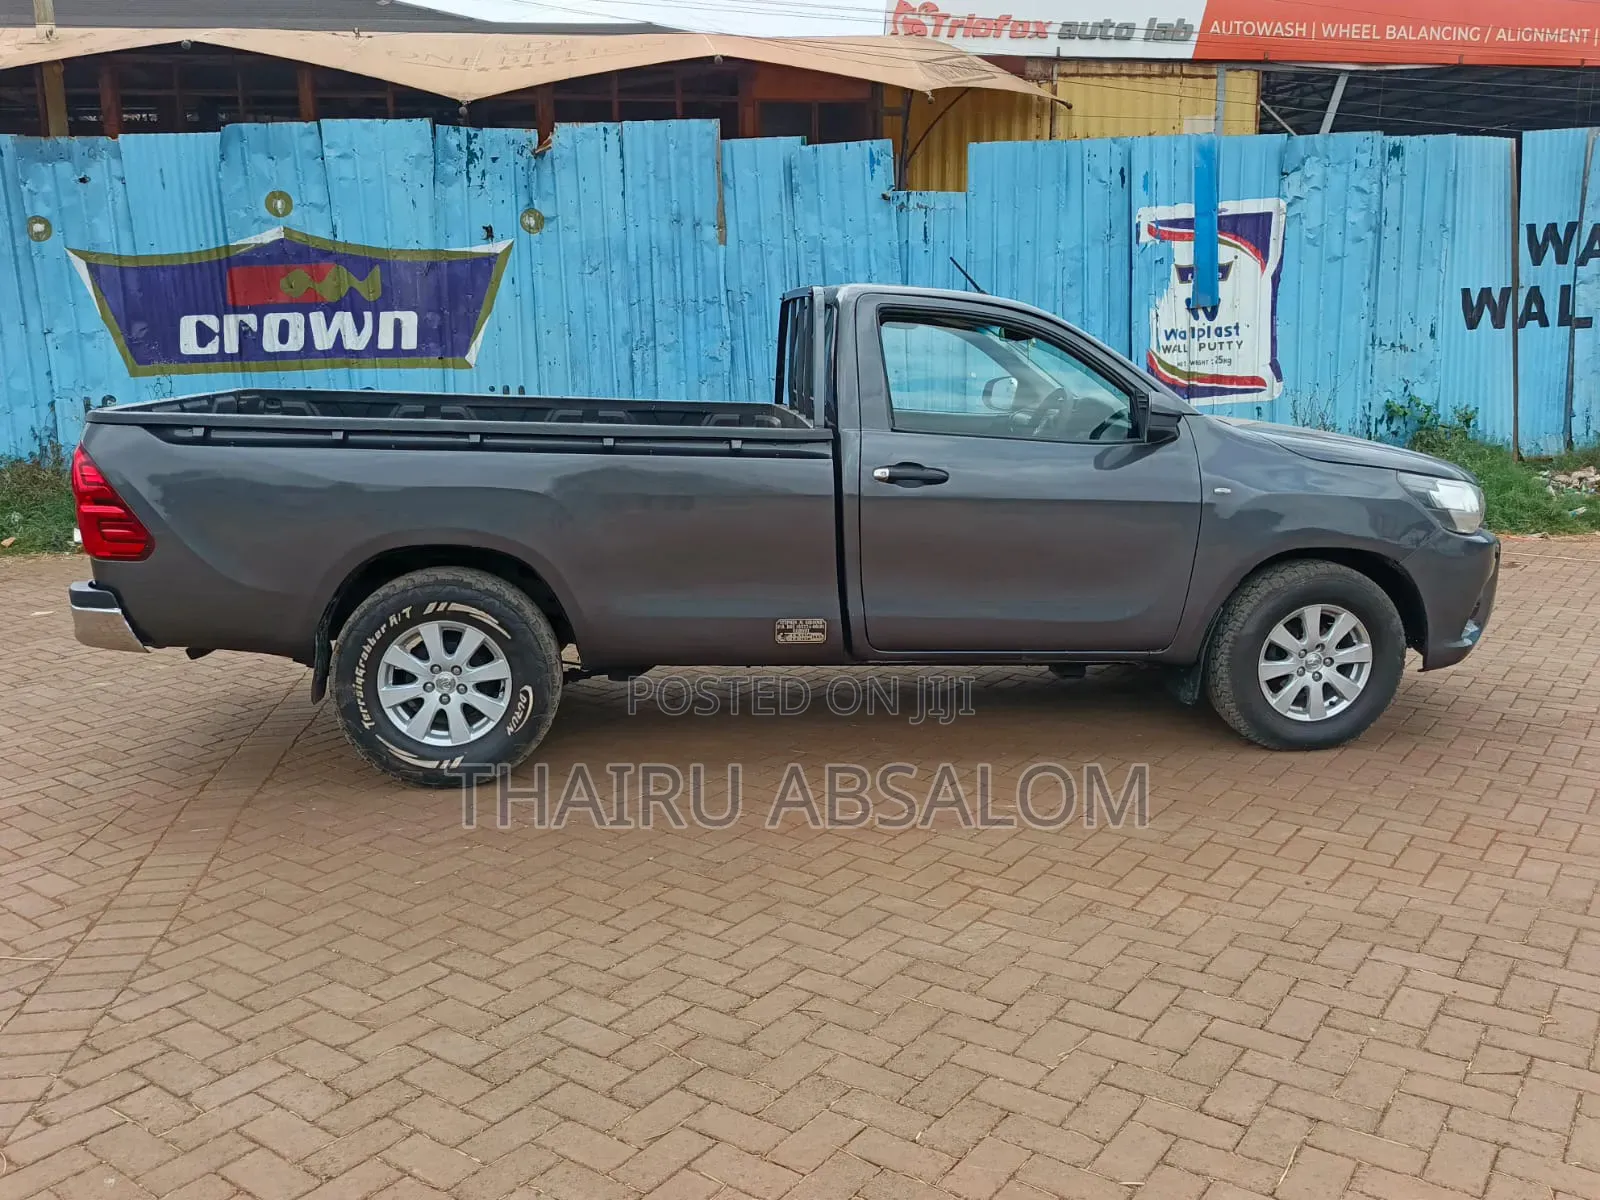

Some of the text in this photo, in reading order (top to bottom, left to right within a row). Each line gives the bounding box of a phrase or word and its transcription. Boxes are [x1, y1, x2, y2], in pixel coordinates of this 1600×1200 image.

[1058, 19, 1136, 40] auto
[1143, 17, 1194, 41] lab
[1210, 20, 1307, 37] AUTOWASH
[1321, 23, 1381, 40] WHEEL
[1385, 24, 1481, 42] BALANCING
[1495, 27, 1590, 44] ALIGNMENT
[1461, 284, 1593, 331] WAL
[179, 310, 418, 355] crown
[1164, 322, 1240, 341] Wallplast
[1161, 340, 1243, 354] WALL PUTTY
